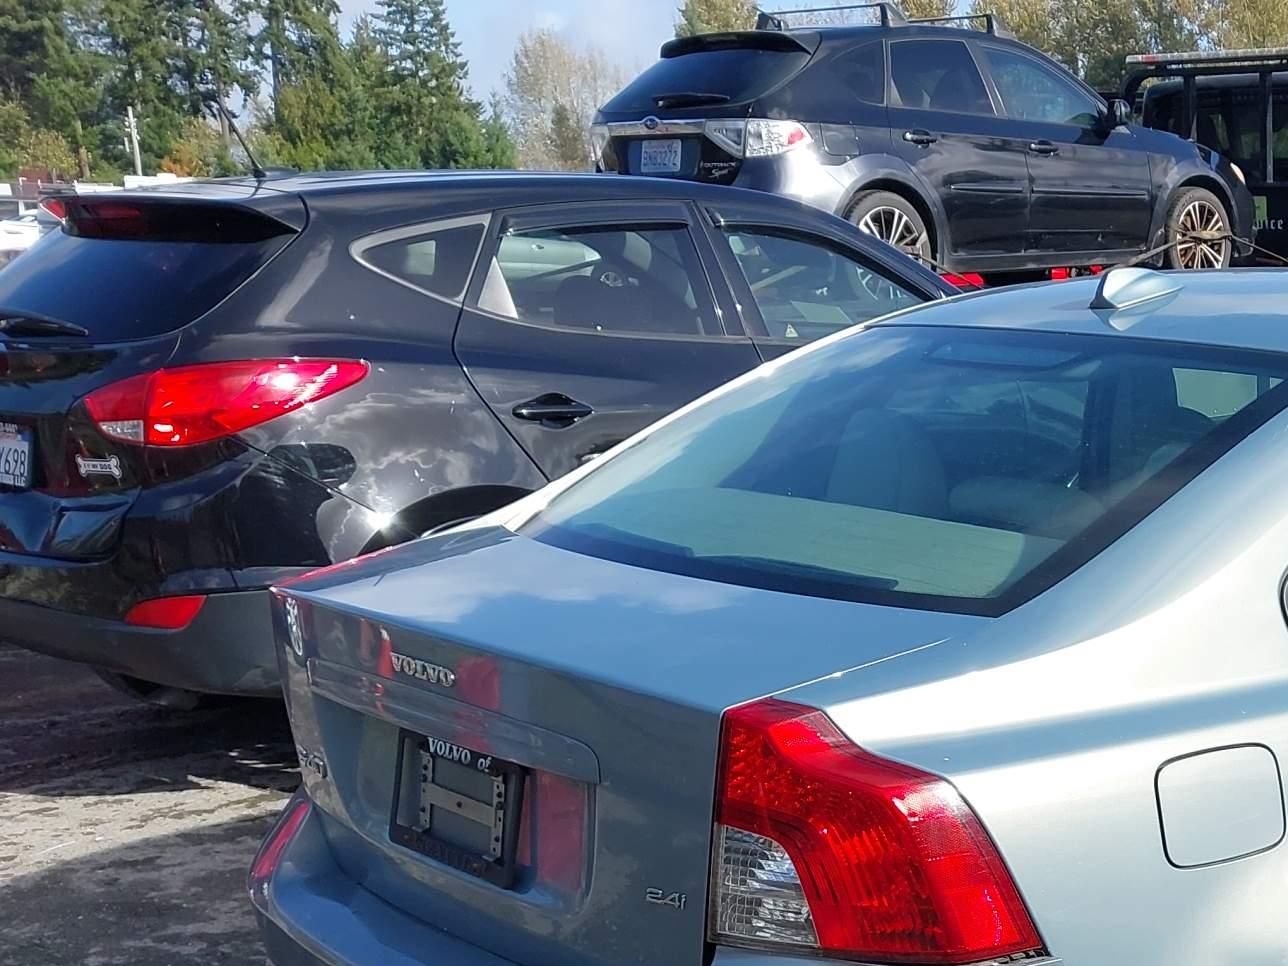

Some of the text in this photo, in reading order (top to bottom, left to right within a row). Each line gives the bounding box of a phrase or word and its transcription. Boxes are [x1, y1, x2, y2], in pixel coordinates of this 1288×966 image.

[390, 651, 457, 688] VOLVO
[426, 737, 492, 773] VOLVO of
